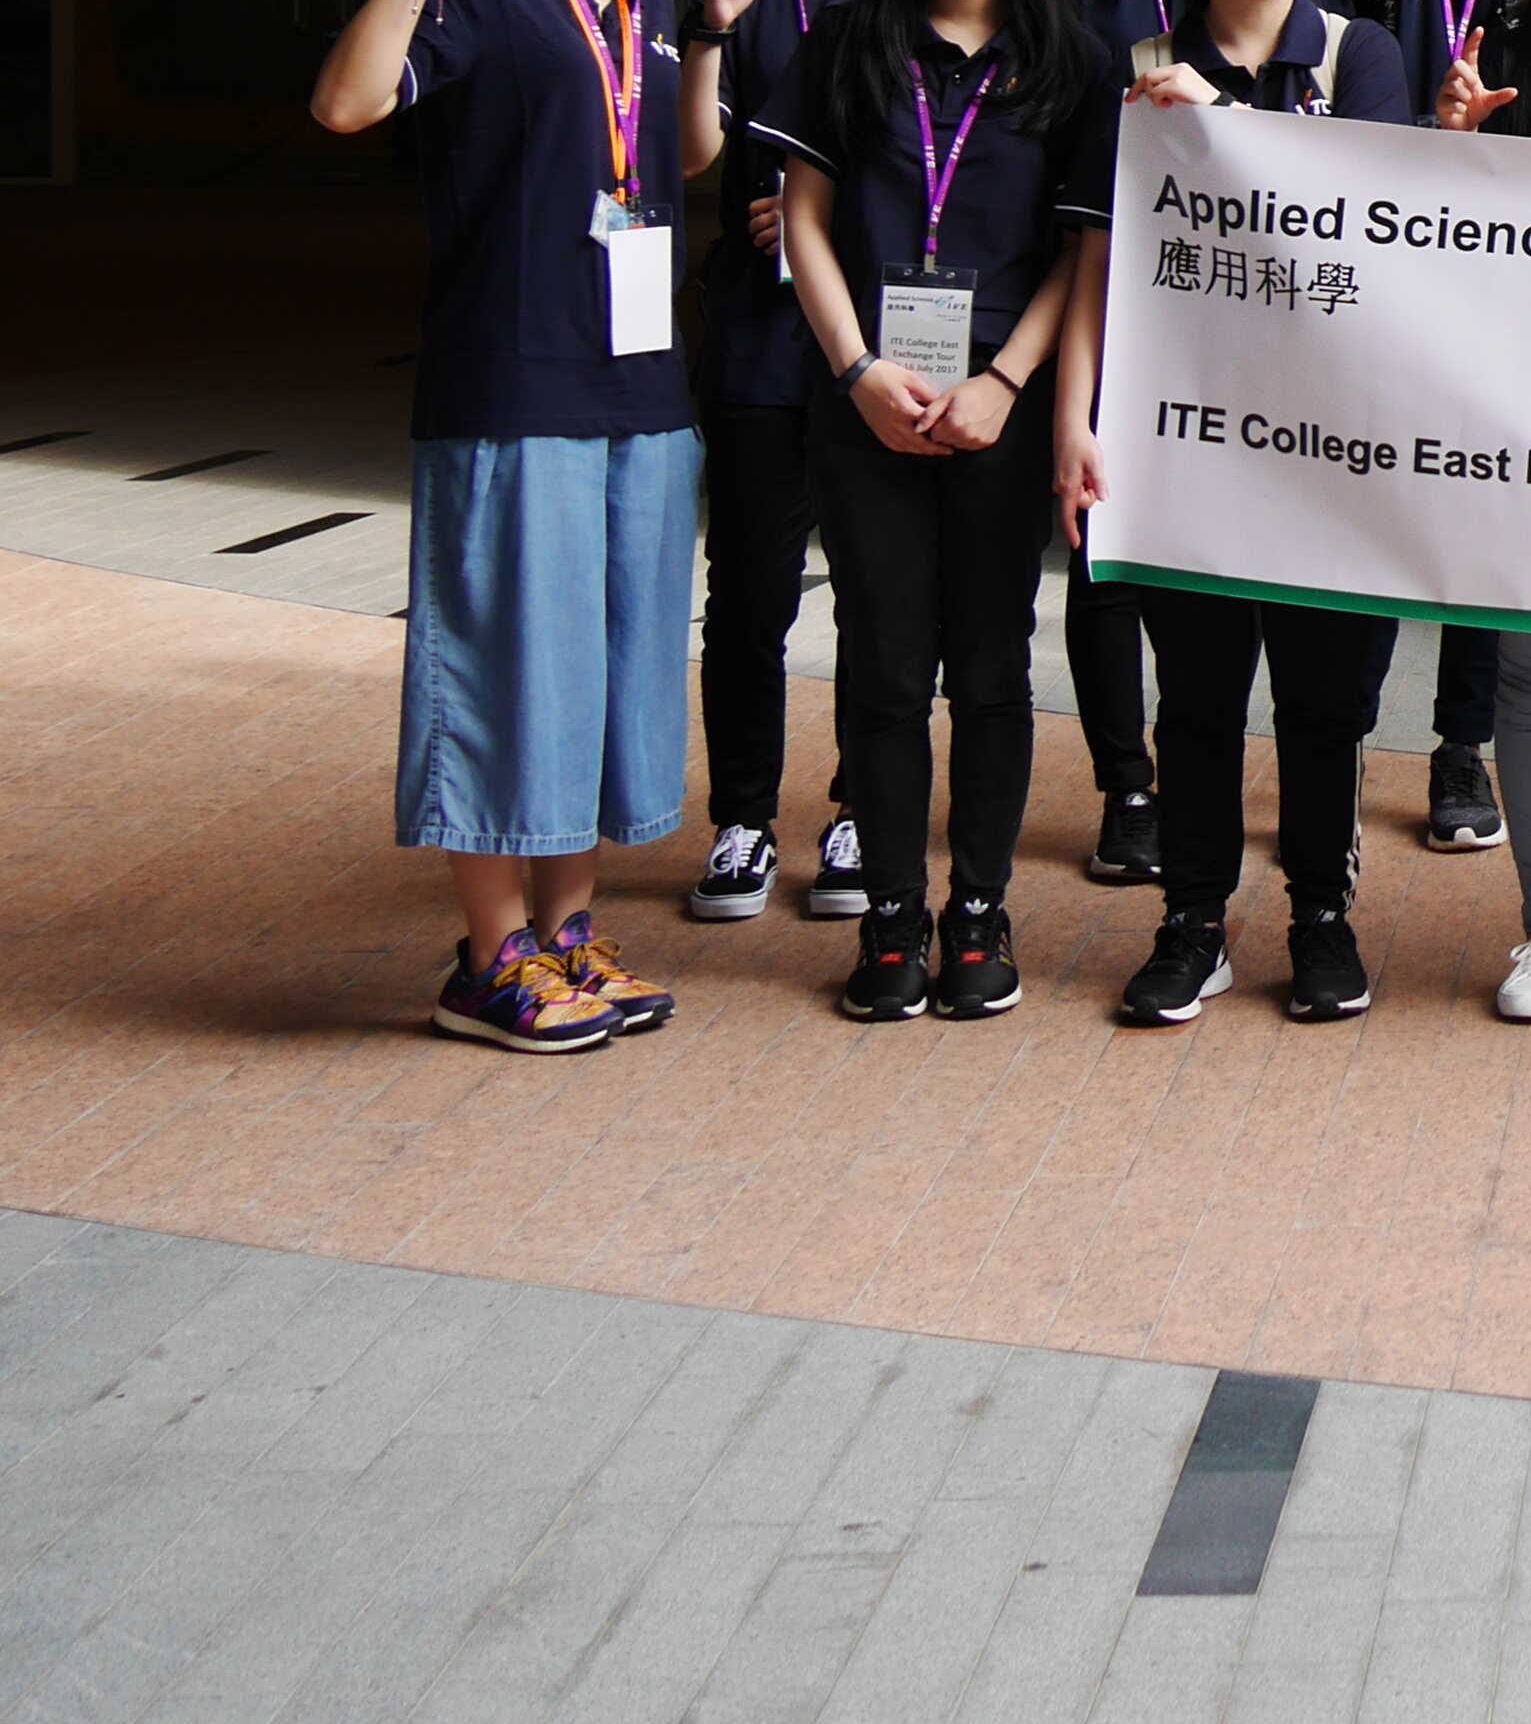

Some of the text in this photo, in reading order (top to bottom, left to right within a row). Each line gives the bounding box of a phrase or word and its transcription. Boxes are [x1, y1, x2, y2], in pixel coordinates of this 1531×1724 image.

[1154, 174, 1346, 240] Applied
[1151, 237, 1360, 316] 應用科學
[906, 338, 938, 348] College
[1156, 400, 1227, 444] ITE
[1240, 412, 1397, 475] College
[1413, 438, 1511, 483] East
